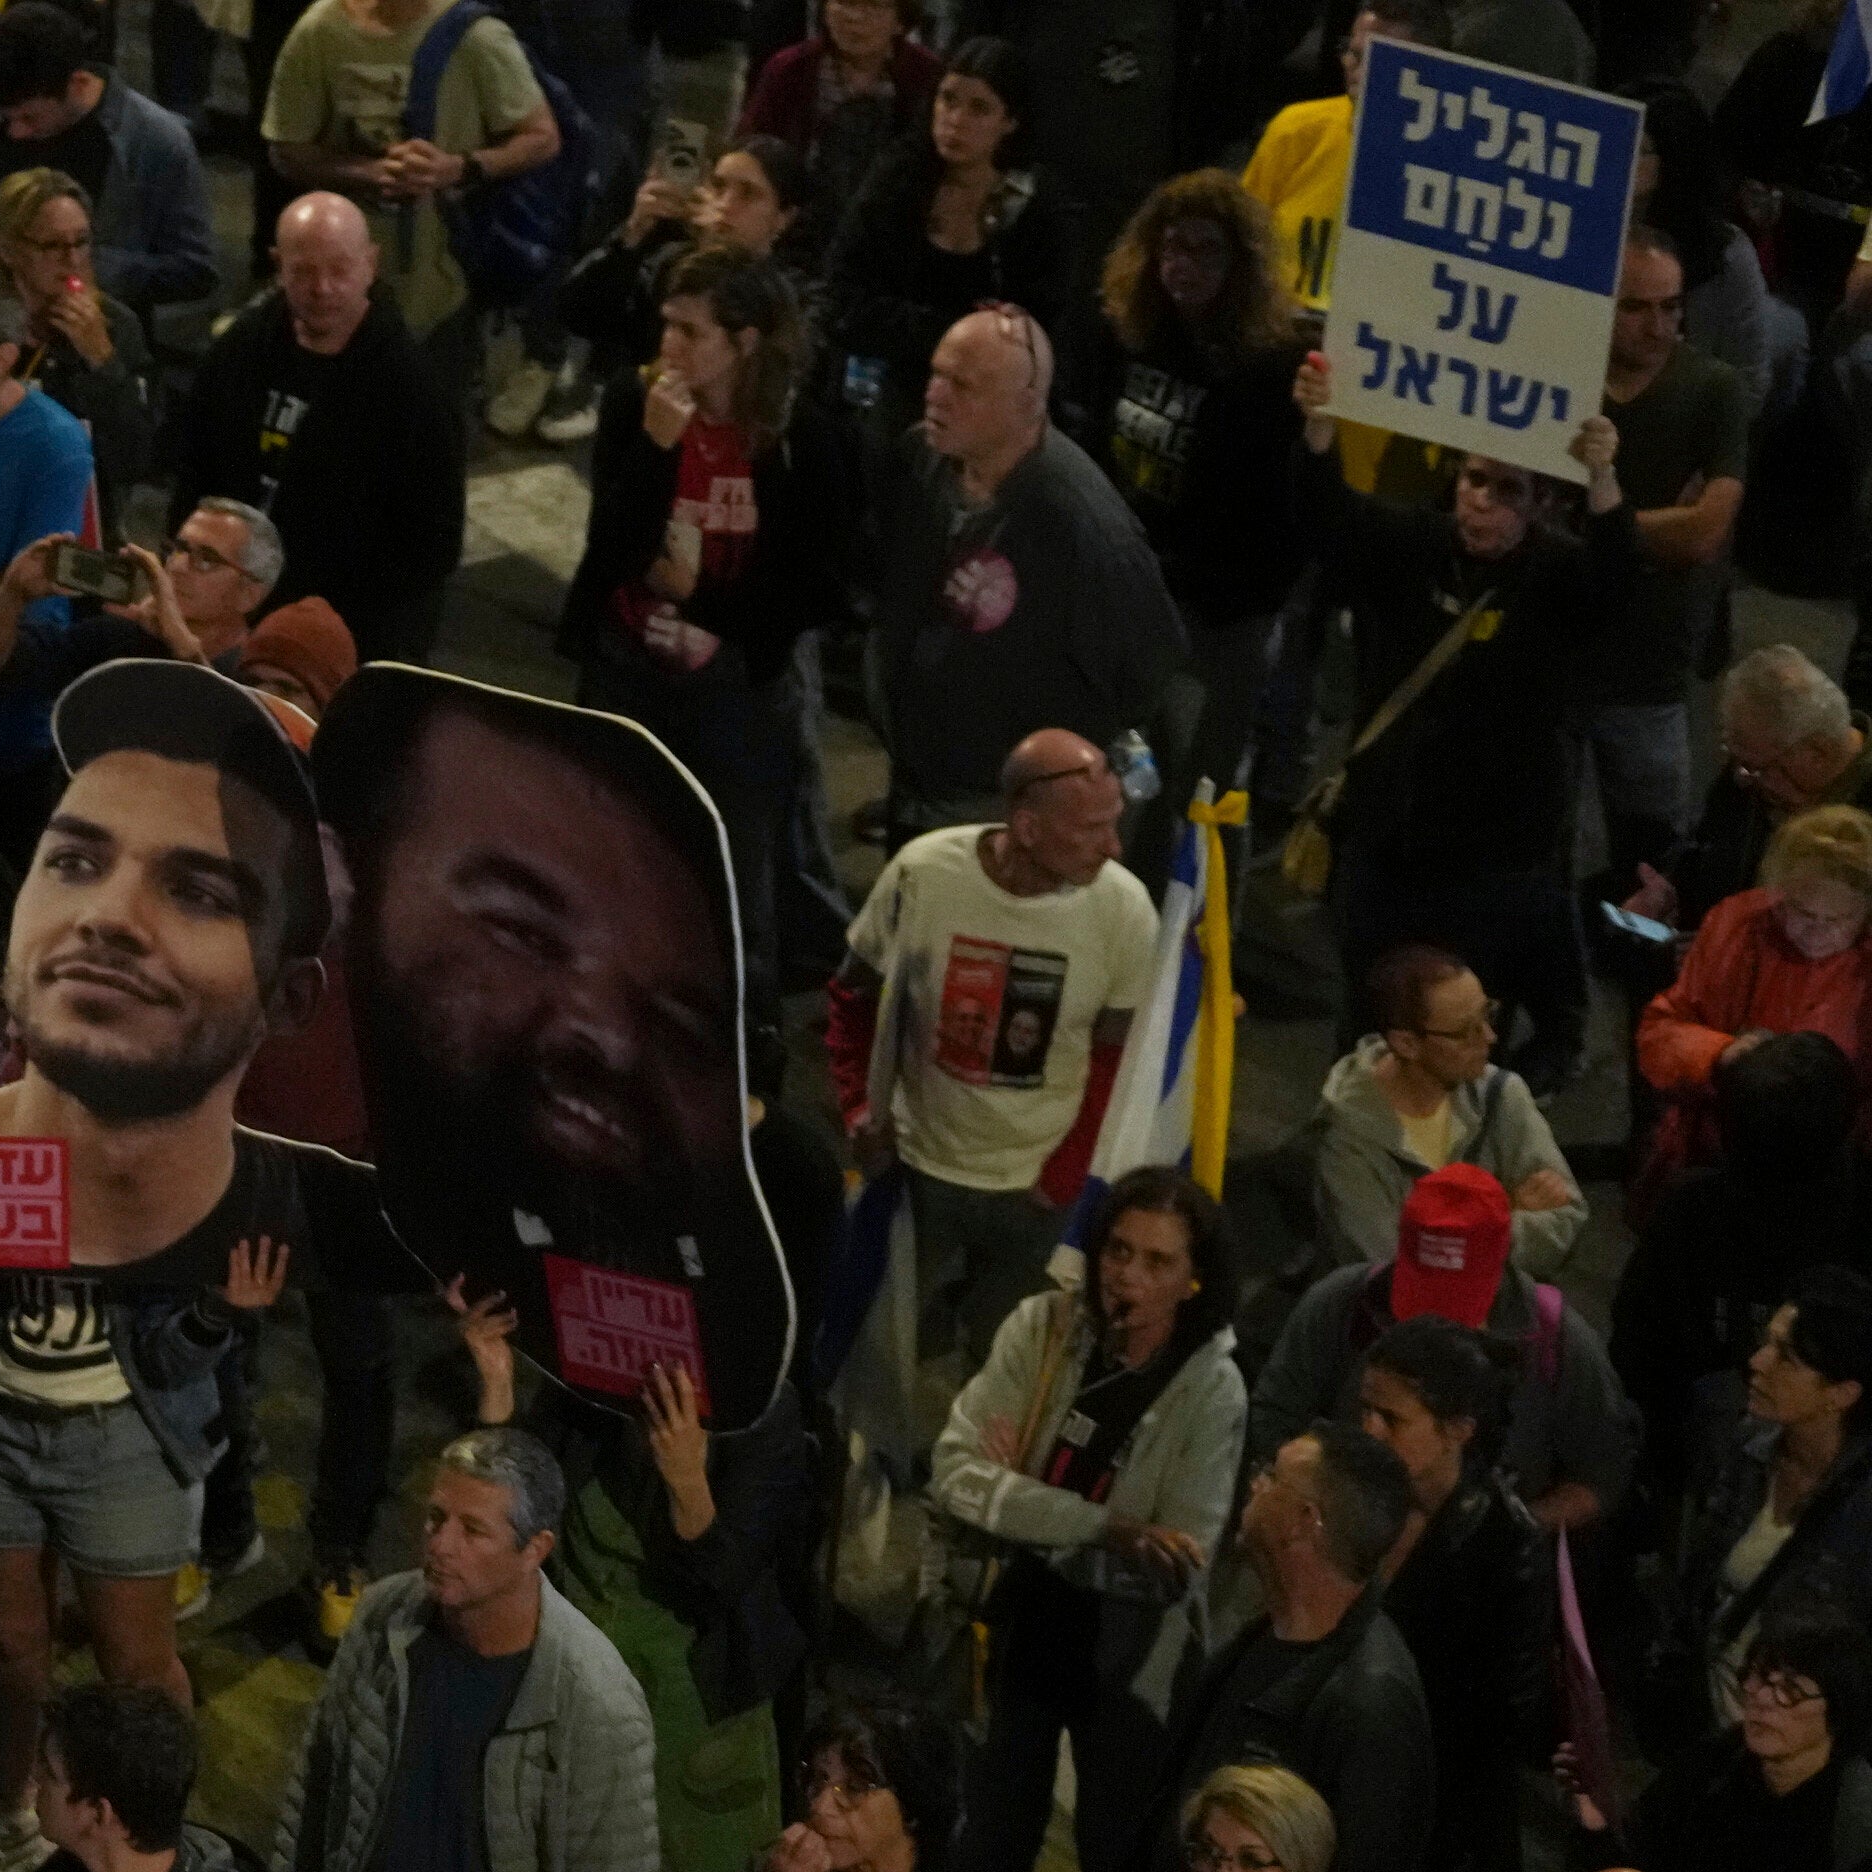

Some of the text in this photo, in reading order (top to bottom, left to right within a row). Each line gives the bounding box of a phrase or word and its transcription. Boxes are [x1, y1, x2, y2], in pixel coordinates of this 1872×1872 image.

[1398, 66, 1602, 189] הגליל
[1432, 262, 1518, 345] על
[1356, 321, 1571, 431] ישראל
[589, 1276, 687, 1333] עדיין
